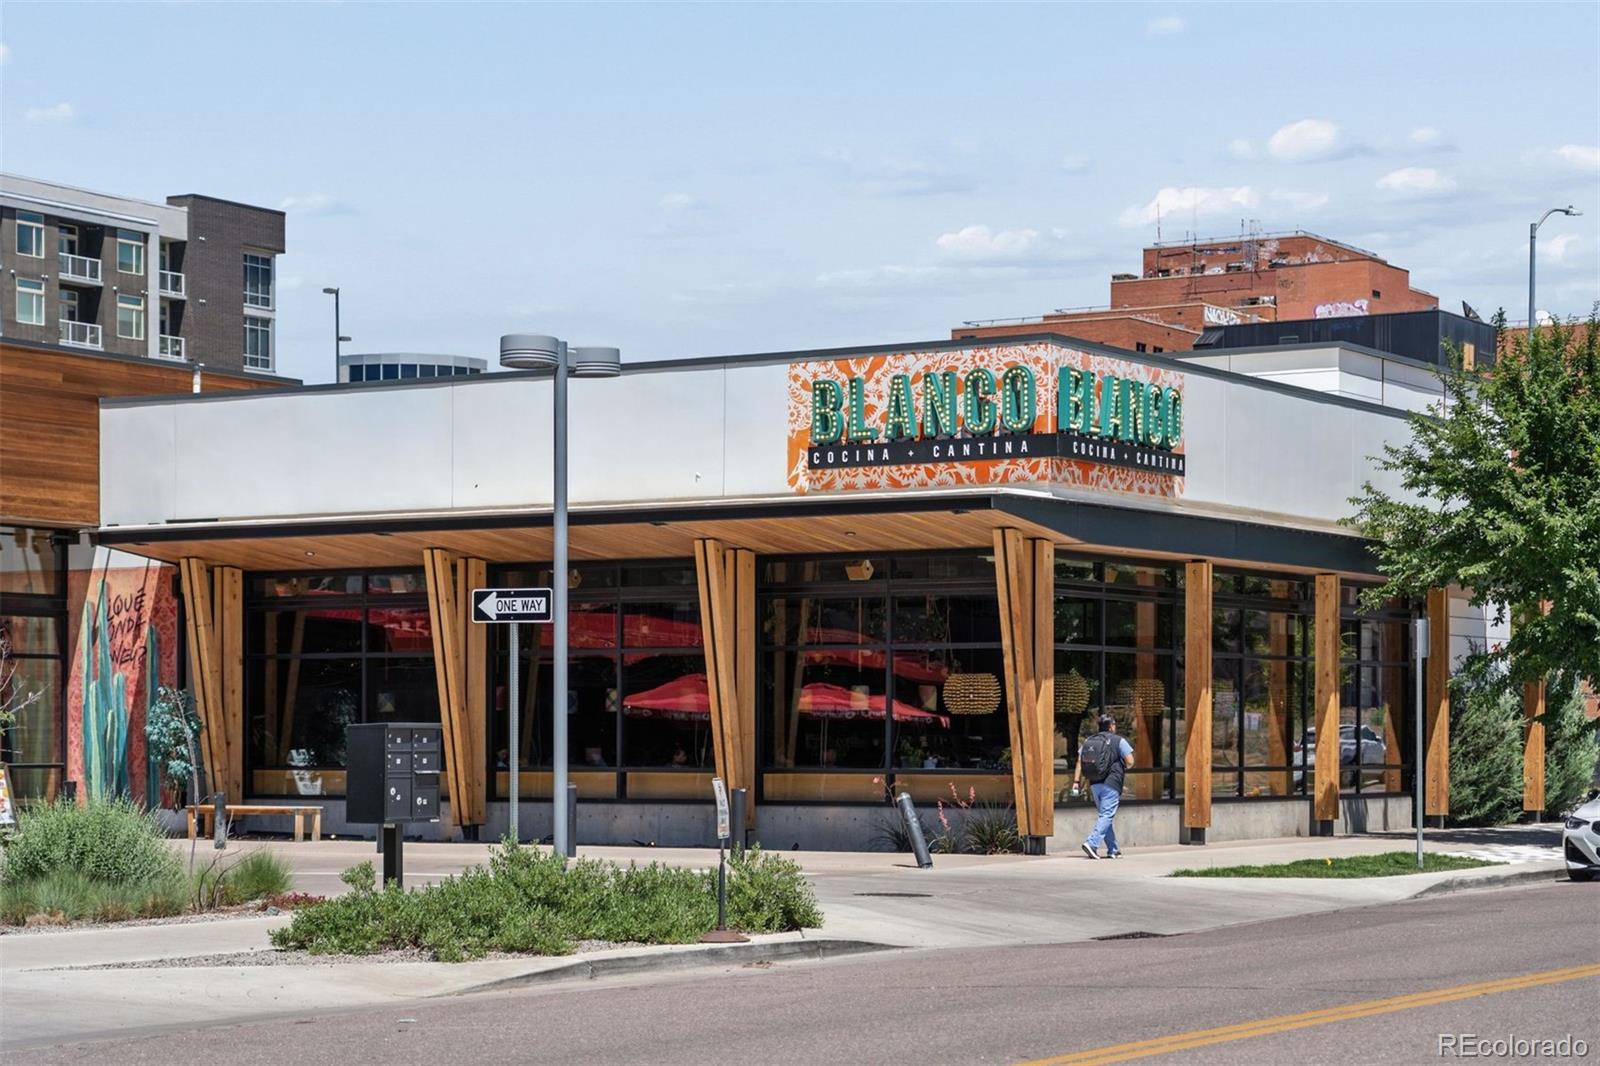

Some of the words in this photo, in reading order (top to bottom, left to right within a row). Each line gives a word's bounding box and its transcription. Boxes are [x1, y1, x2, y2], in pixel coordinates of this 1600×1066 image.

[813, 365, 1036, 444] BLANCO
[1059, 366, 1181, 450] BLANCO
[813, 449, 889, 464] COCINA
[933, 440, 1028, 457] CANTINA
[1073, 441, 1116, 460] COCINA
[1136, 452, 1184, 471] CANTINA
[496, 600, 517, 612] ONE
[521, 600, 543, 611] WAY
